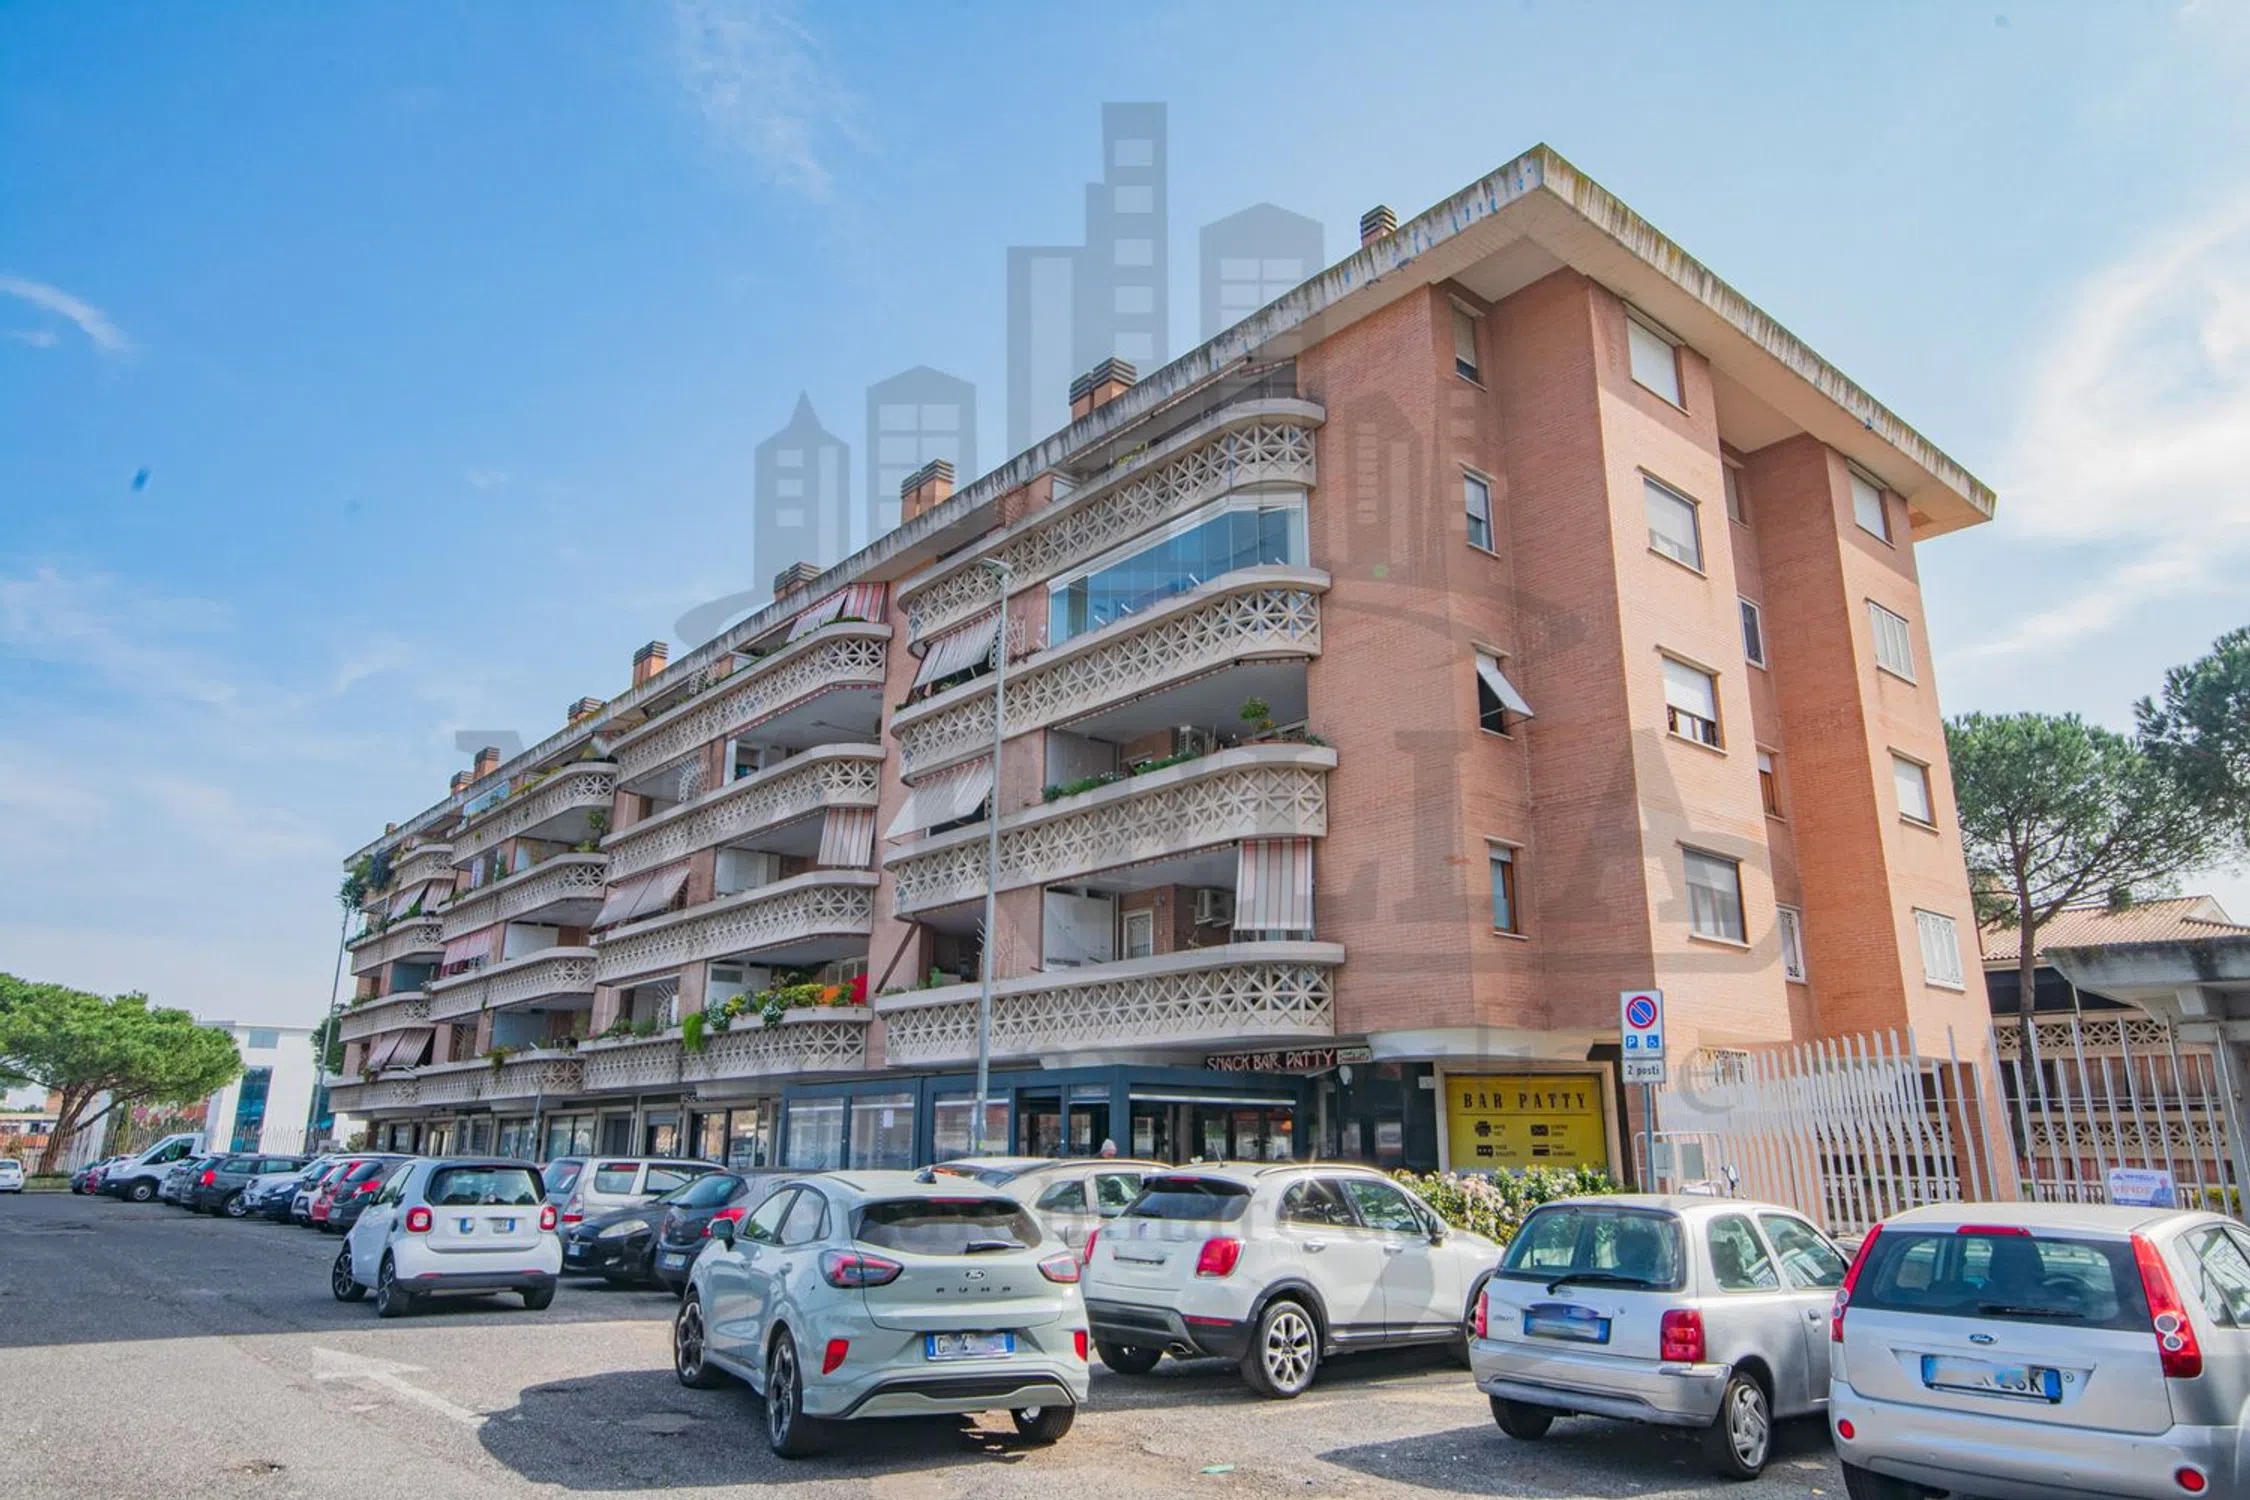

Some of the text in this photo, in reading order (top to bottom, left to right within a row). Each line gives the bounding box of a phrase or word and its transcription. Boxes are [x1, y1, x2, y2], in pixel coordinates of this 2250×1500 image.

[1206, 1056, 1250, 1072] SNACK
[1253, 1053, 1281, 1070] BAR
[1286, 1048, 1335, 1068] PATTY
[1628, 1064, 1660, 1077] 2 posti
[1464, 1092, 1586, 1109] BAR PATTY
